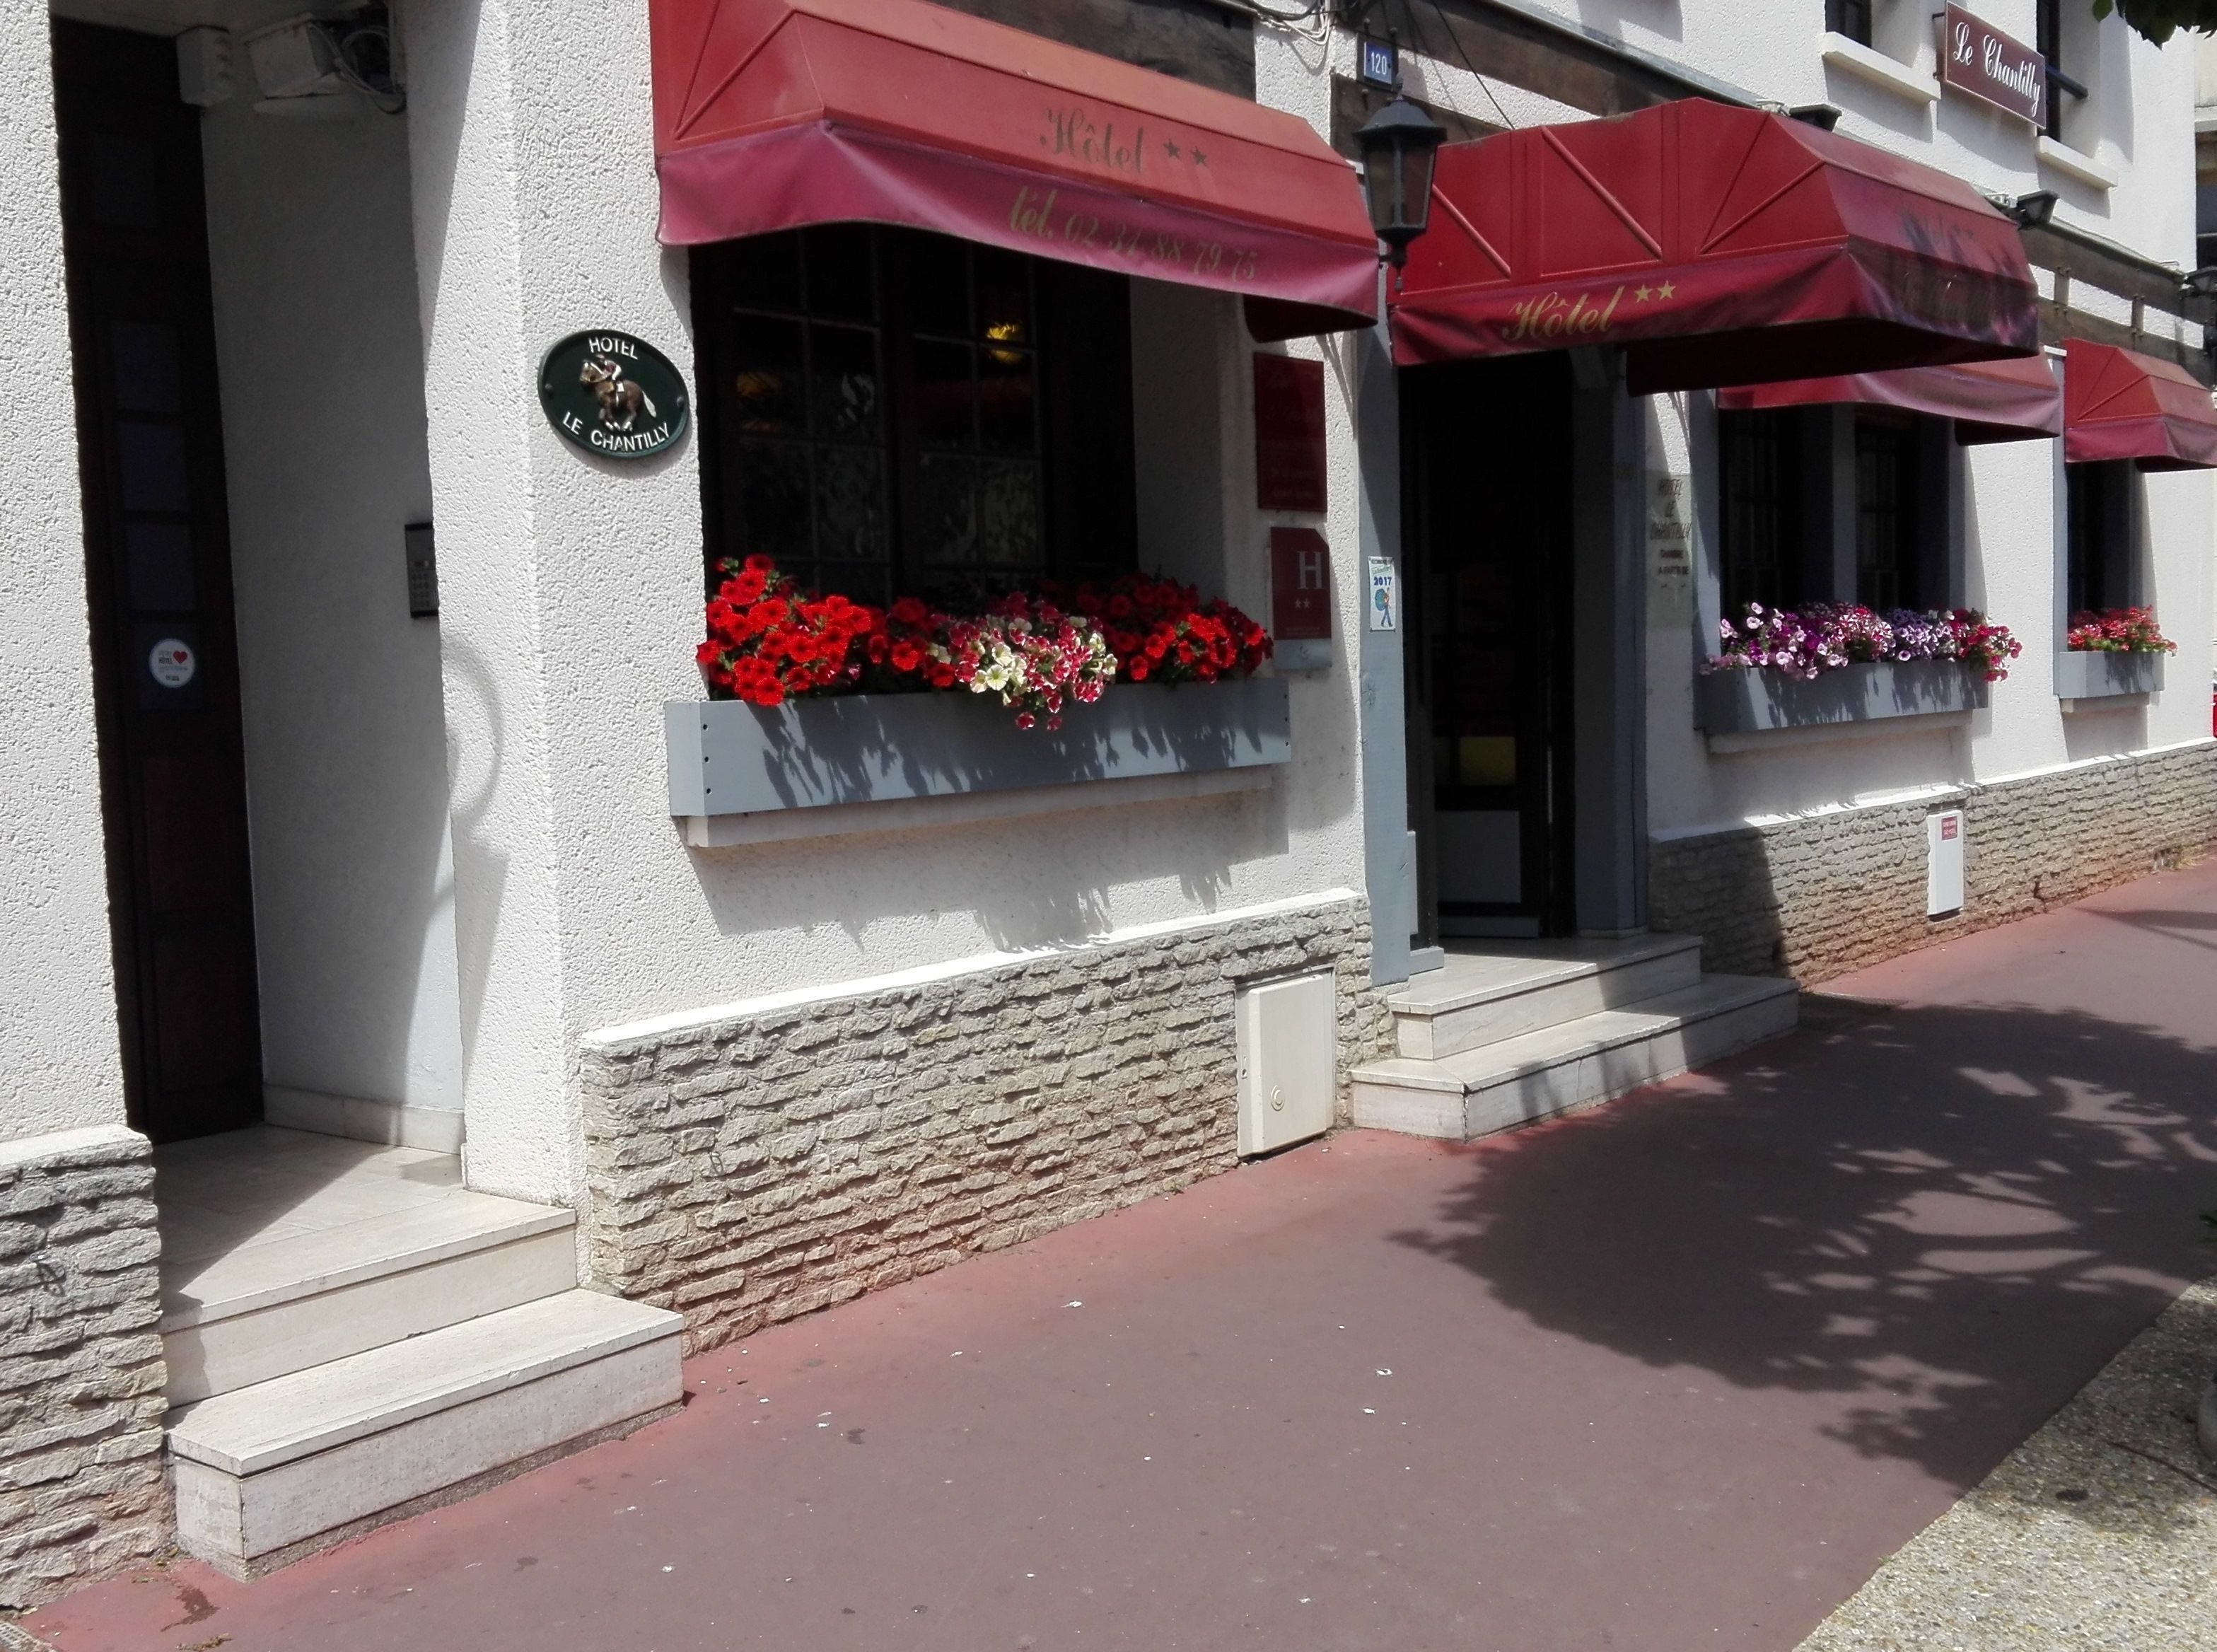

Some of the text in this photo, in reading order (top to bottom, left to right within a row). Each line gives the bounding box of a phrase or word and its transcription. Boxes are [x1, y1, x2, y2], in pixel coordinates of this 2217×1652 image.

[1371, 52, 1387, 75] 120
[1953, 21, 2041, 117] Le Chantilly
[1040, 107, 1144, 174] Hôtel
[1065, 214, 1099, 248] 02
[1151, 231, 1184, 263] 88
[1502, 285, 1625, 339] Hôtel
[588, 337, 639, 360] HOTEL
[563, 412, 670, 451] LE CHANTILLY
[1297, 551, 1324, 590] H
[1373, 576, 1392, 586] 2017
